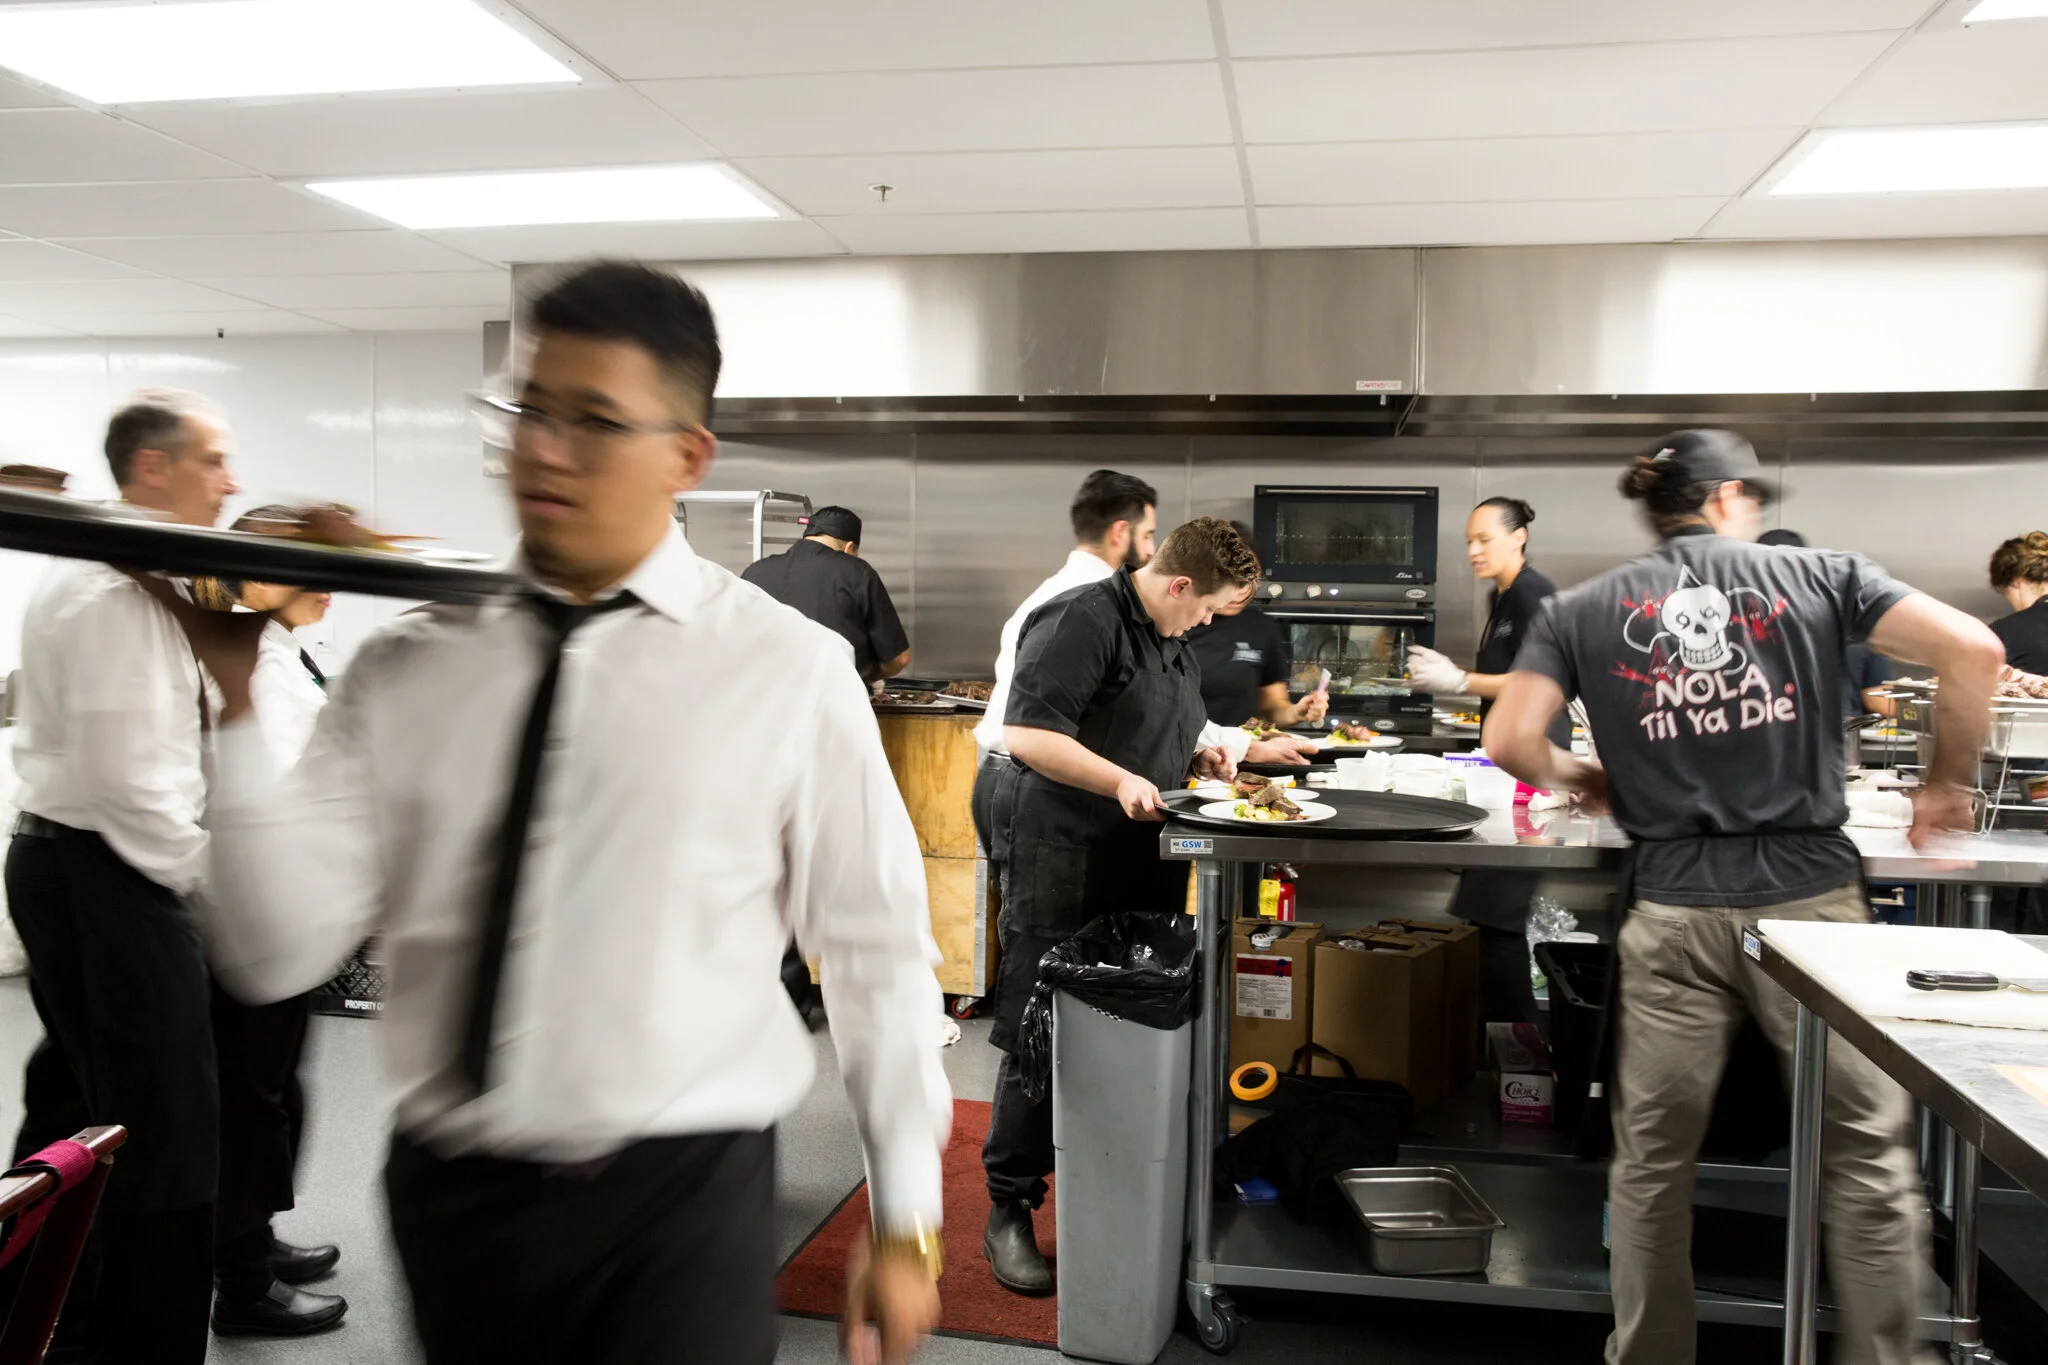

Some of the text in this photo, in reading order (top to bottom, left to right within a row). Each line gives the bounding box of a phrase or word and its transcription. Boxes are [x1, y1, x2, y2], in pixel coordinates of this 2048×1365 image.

[1655, 663, 1771, 708] NOLA
[1640, 691, 1796, 741] Til Ya Die
[1181, 840, 1202, 848] GSW
[345, 999, 377, 1010] PROPERTY
[1505, 1081, 1541, 1101] CHOICE
